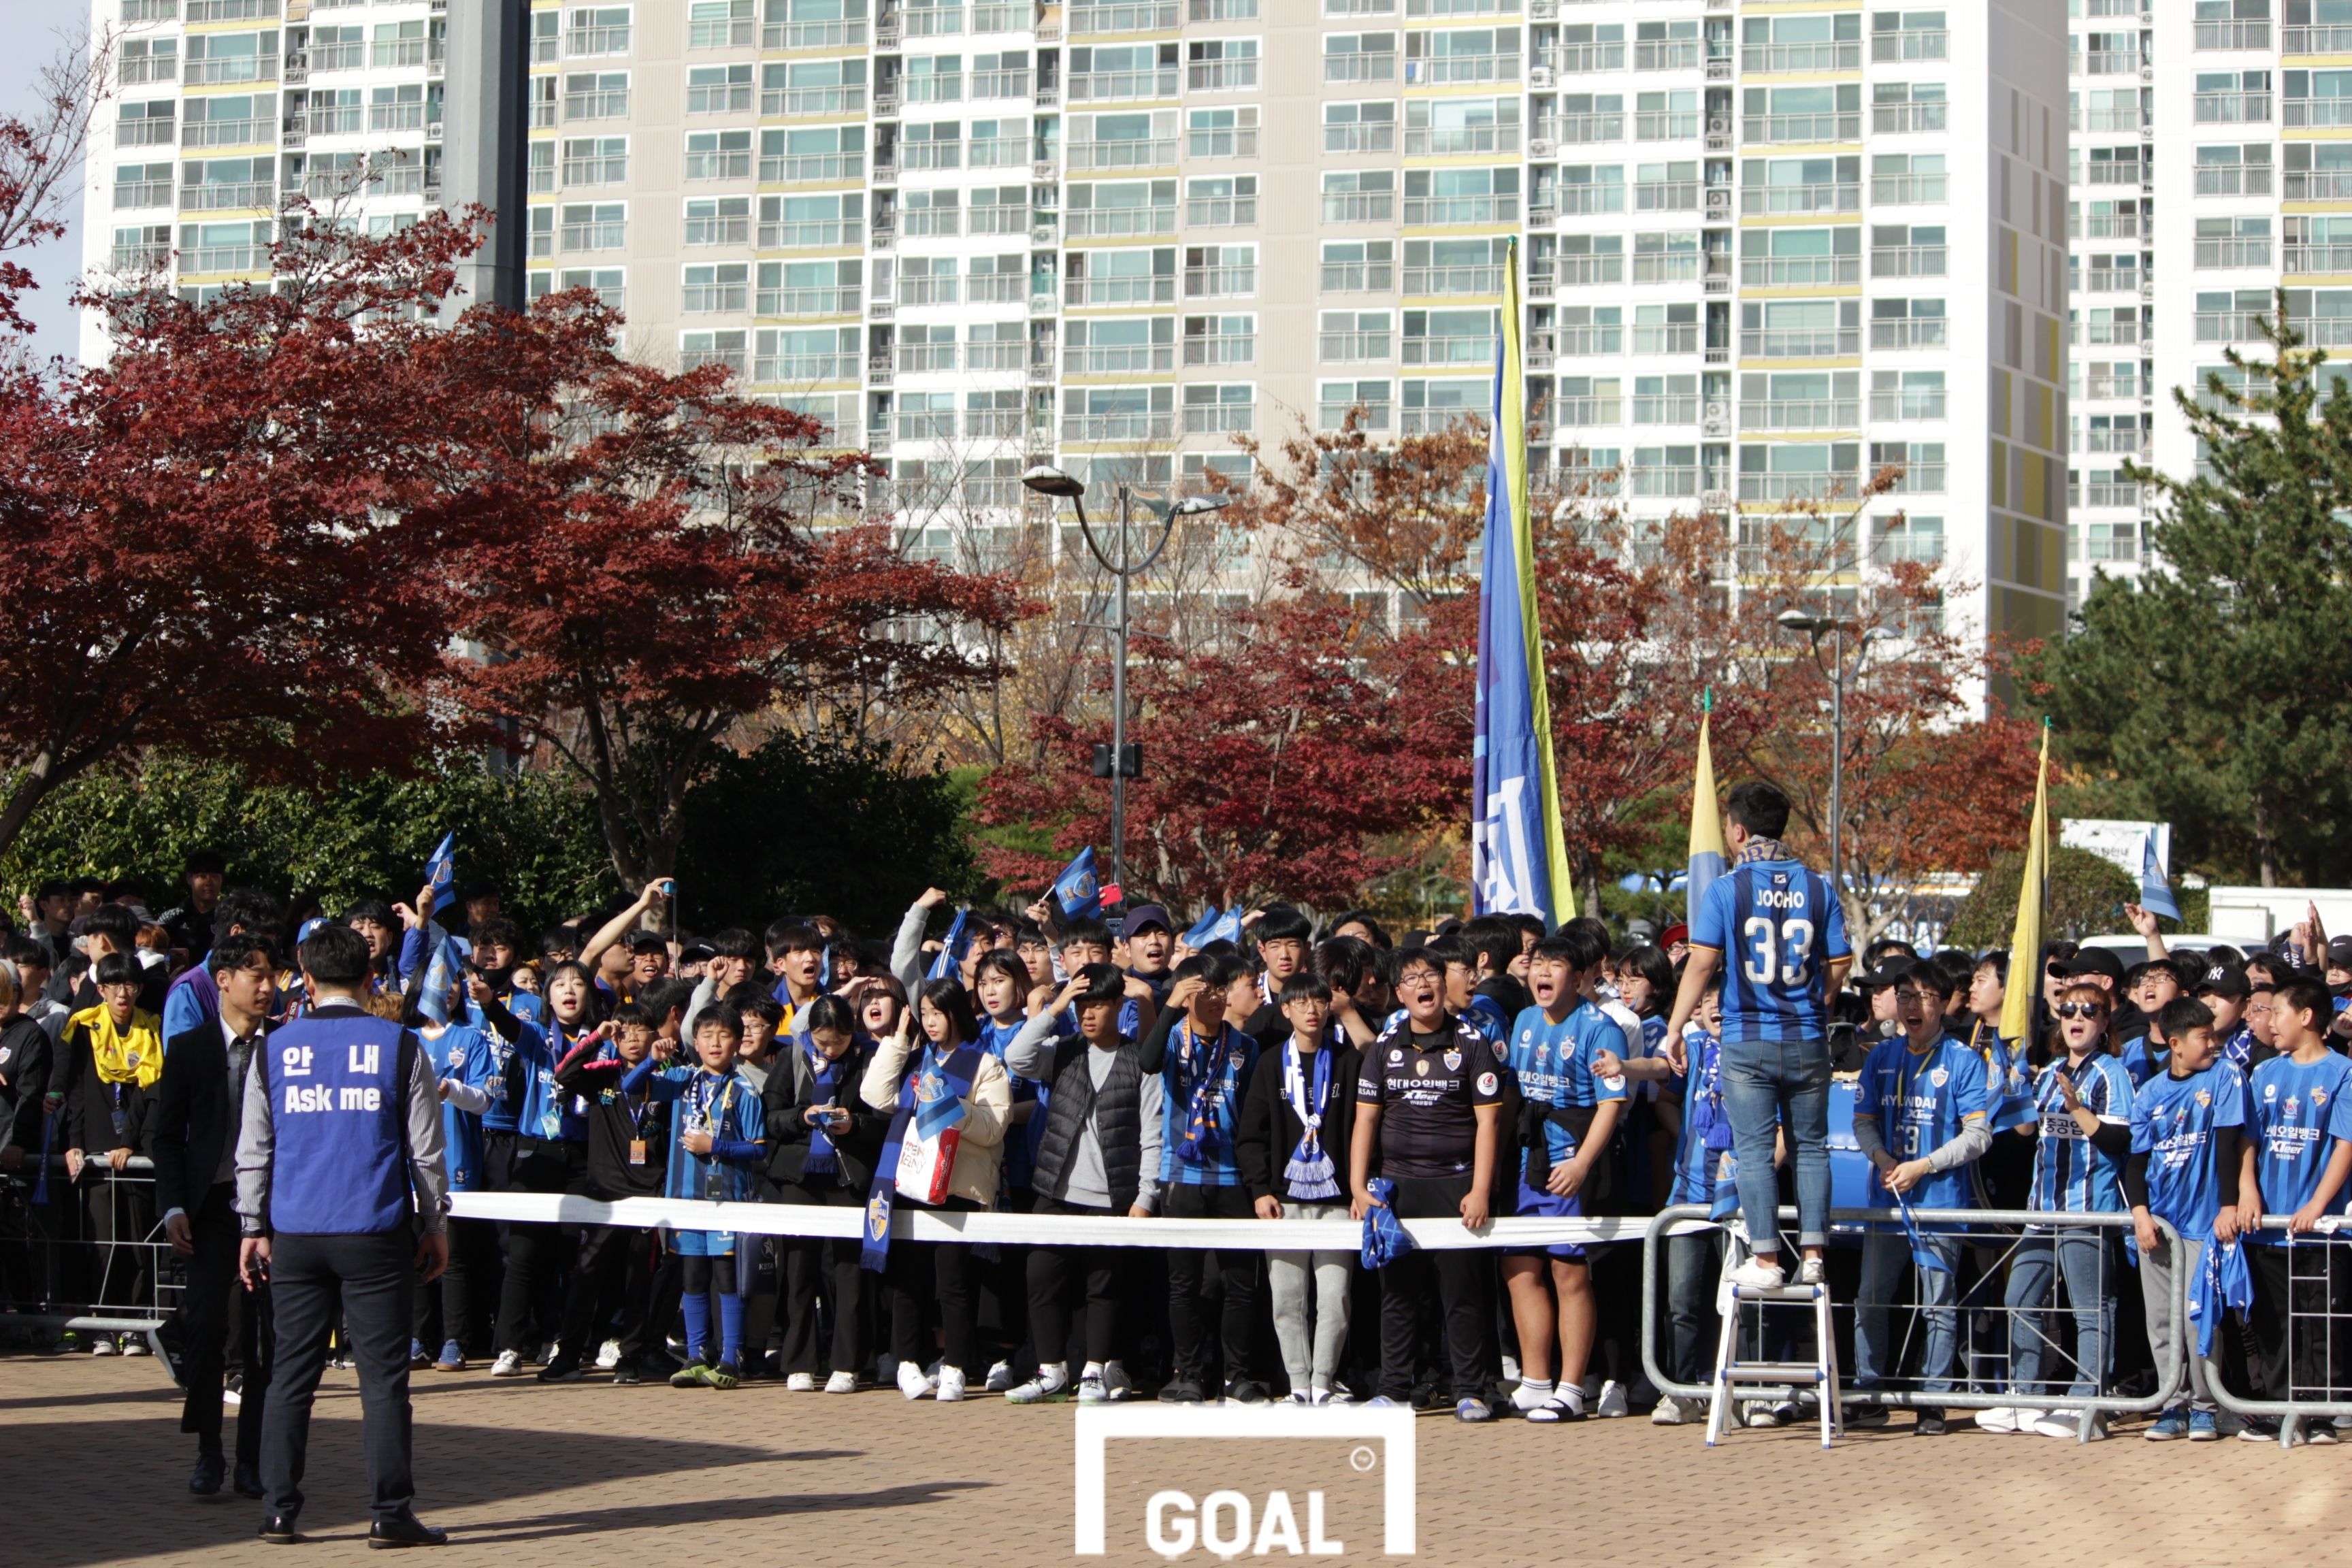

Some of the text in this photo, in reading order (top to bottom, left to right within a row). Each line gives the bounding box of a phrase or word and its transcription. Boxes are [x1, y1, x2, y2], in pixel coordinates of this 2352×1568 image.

[1757, 889, 1806, 909] JOOHO
[1744, 916, 1815, 987] 33
[285, 1083, 380, 1113] Ask me
[1881, 1094, 1937, 1110] HYNDAI
